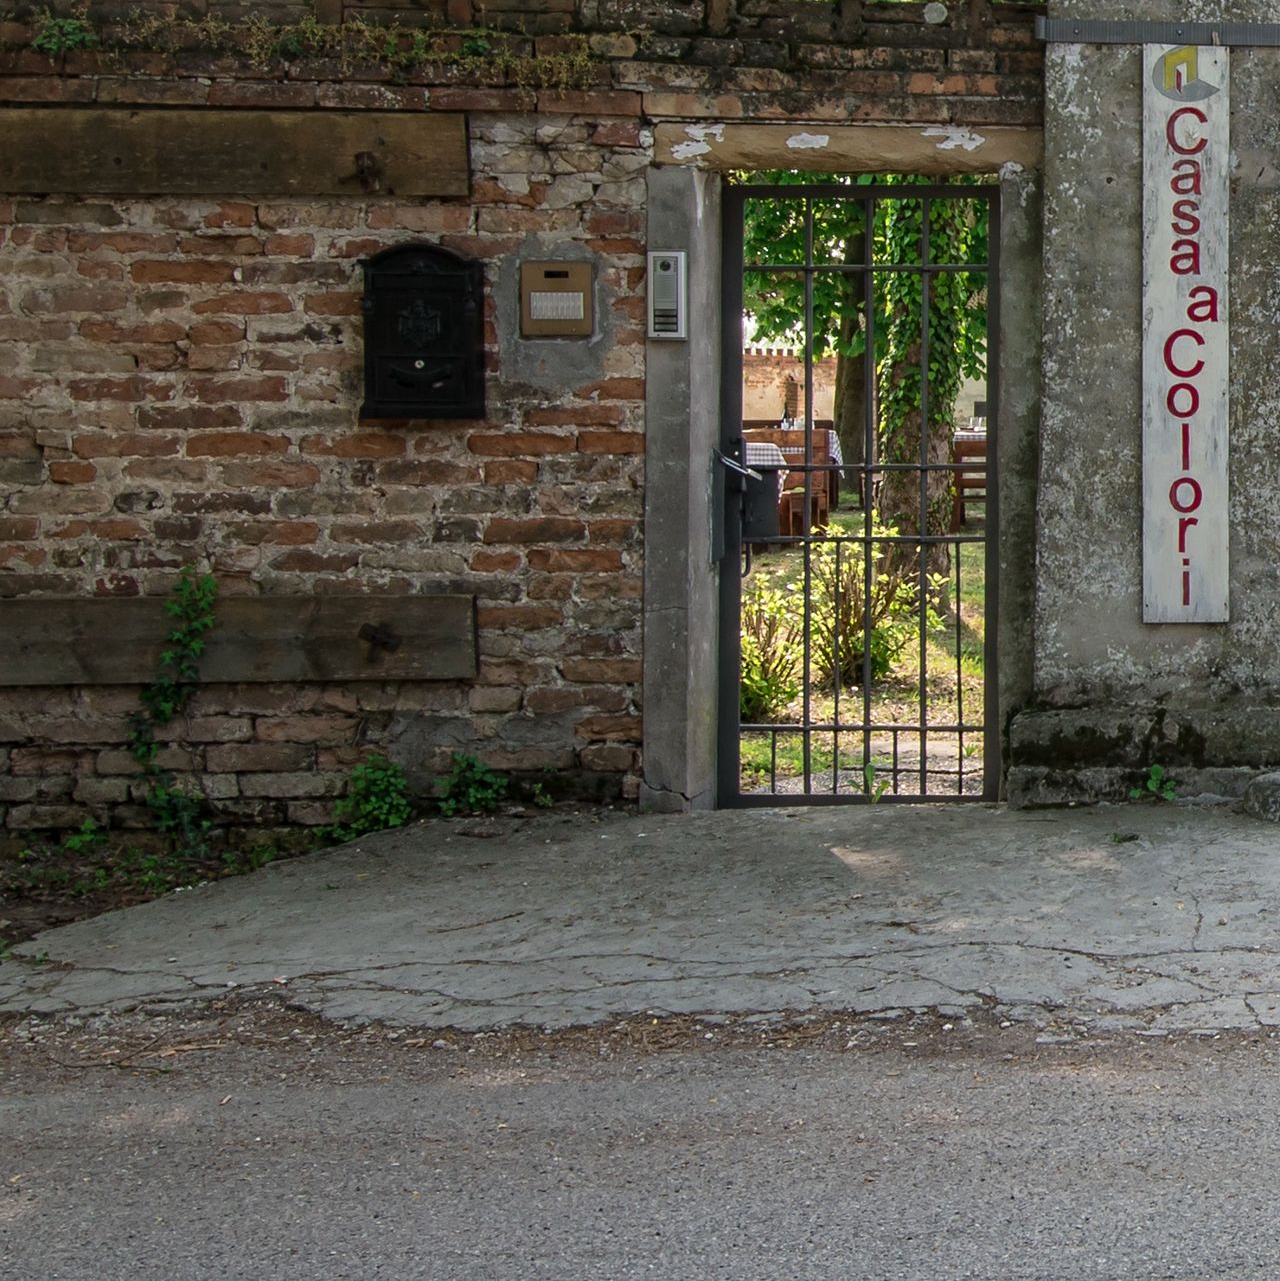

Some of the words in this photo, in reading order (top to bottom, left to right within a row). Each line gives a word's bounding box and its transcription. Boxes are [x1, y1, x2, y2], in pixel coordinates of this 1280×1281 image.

[1166, 106, 1209, 276] Casa
[1187, 284, 1219, 324] a
[1162, 328, 1206, 607] Colori
